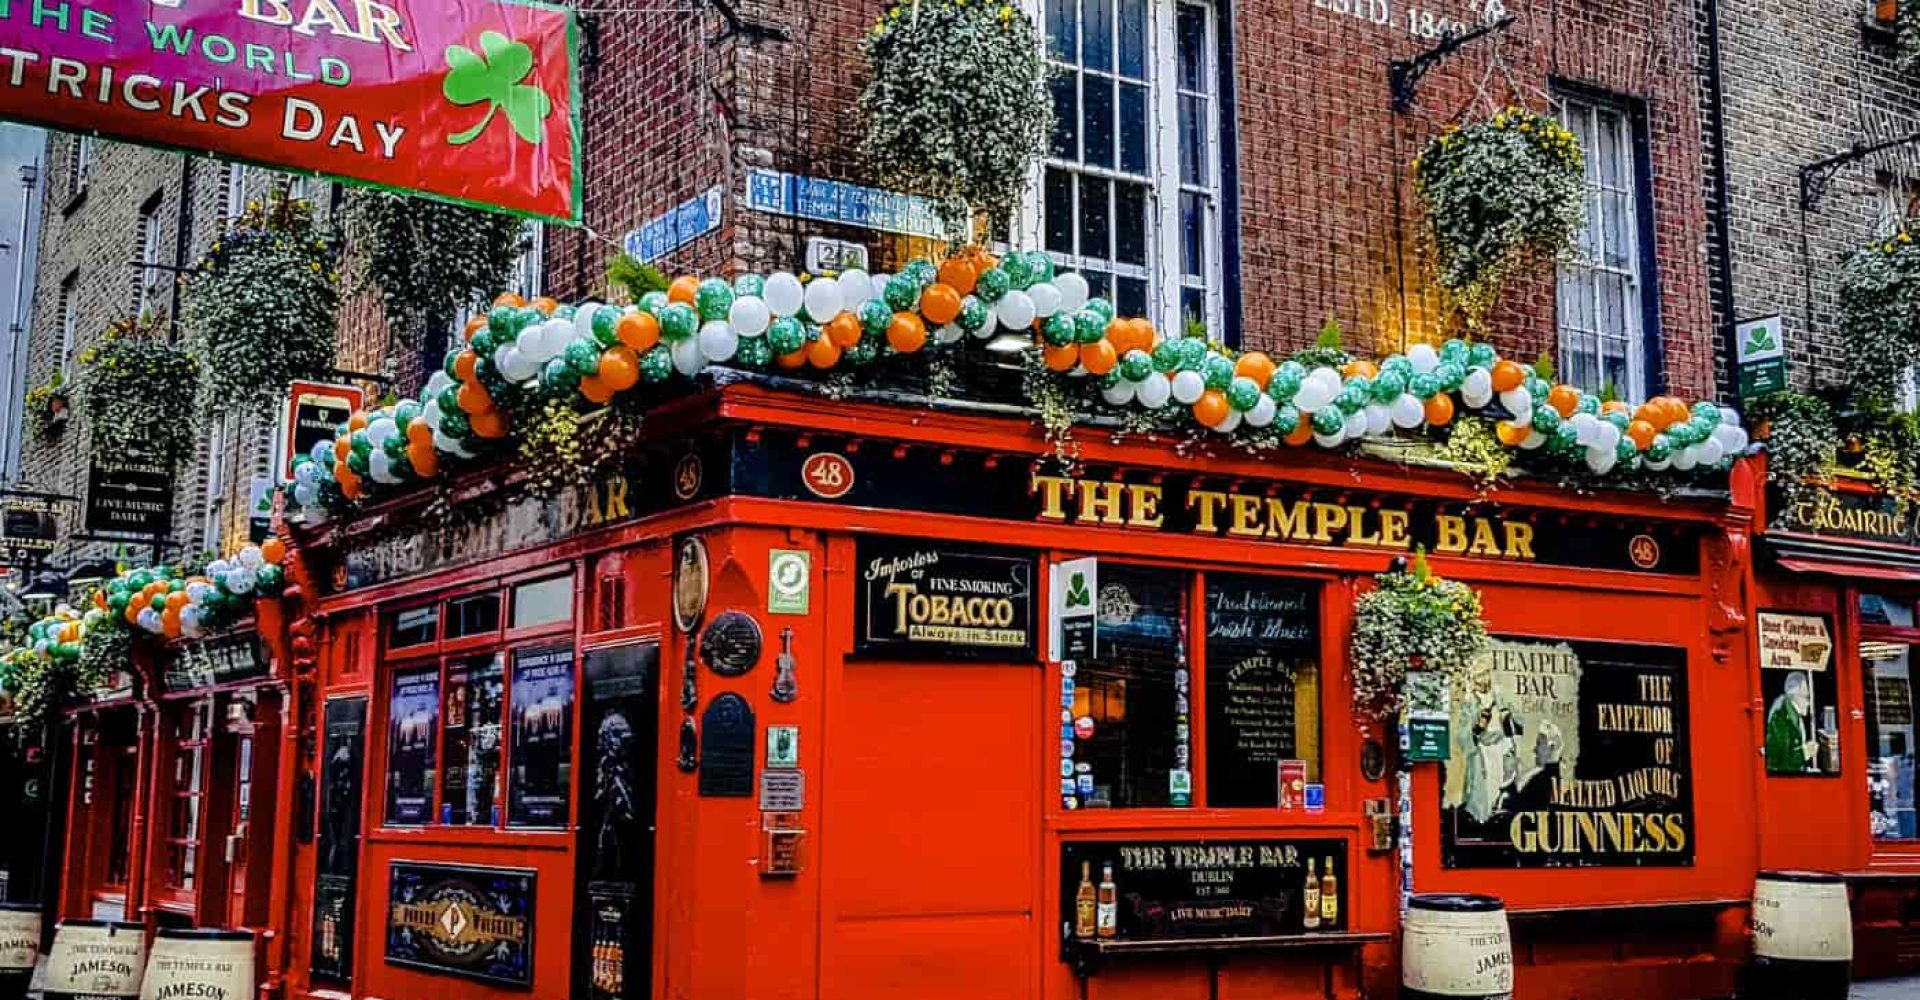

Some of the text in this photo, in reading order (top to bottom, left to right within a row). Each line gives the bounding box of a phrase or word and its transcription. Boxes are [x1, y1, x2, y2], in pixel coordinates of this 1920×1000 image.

[146, 22, 351, 85] WORLD
[280, 97, 405, 158] DAY
[799, 200, 848, 219] TEMPLE
[853, 208, 889, 225] LANE
[811, 457, 843, 486] 48
[1033, 475, 1537, 560] THE TEMPLE BAR
[1633, 540, 1656, 560] 48
[864, 551, 939, 583] Importers
[930, 577, 1013, 595] FINE SMOKING
[883, 583, 1014, 634] TOBACCO
[1492, 649, 1574, 675] TEMPLE
[1514, 674, 1558, 700] BAR
[1637, 674, 1672, 702] THE
[1597, 703, 1674, 734] EMPEROR
[1654, 737, 1674, 765] OF
[1550, 767, 1683, 808] MALTED LIQUORS
[1510, 811, 1686, 853] GUINNESS
[1119, 844, 1301, 871] THE TEMPLE BAR
[1191, 871, 1235, 883] DUBLIN
[71, 960, 133, 977] JAMESON
[155, 982, 230, 1000] JAMESON
